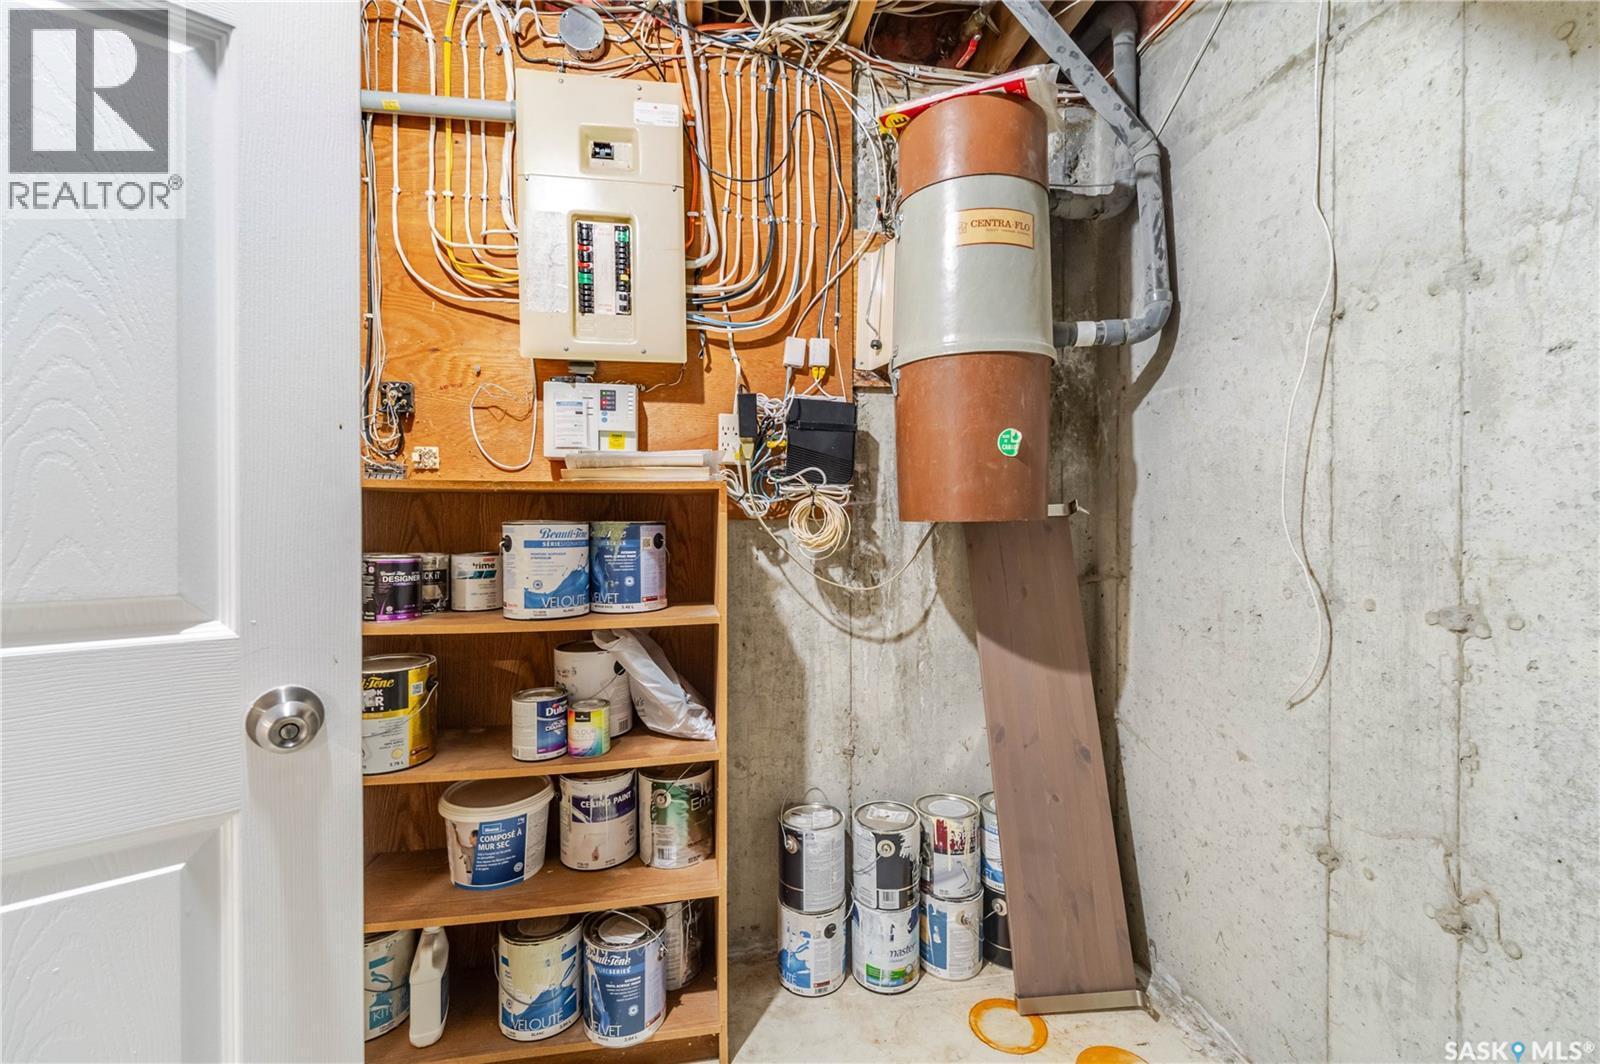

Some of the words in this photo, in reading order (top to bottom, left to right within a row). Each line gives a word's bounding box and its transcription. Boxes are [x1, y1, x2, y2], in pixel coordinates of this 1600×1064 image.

[382, 574, 420, 583] DESIGNER
[592, 592, 620, 604] ELVET
[613, 790, 632, 804] PAINT
[480, 829, 516, 843] COMPOSÉ
[478, 843, 496, 851] MUR
[496, 840, 510, 849] SEC
